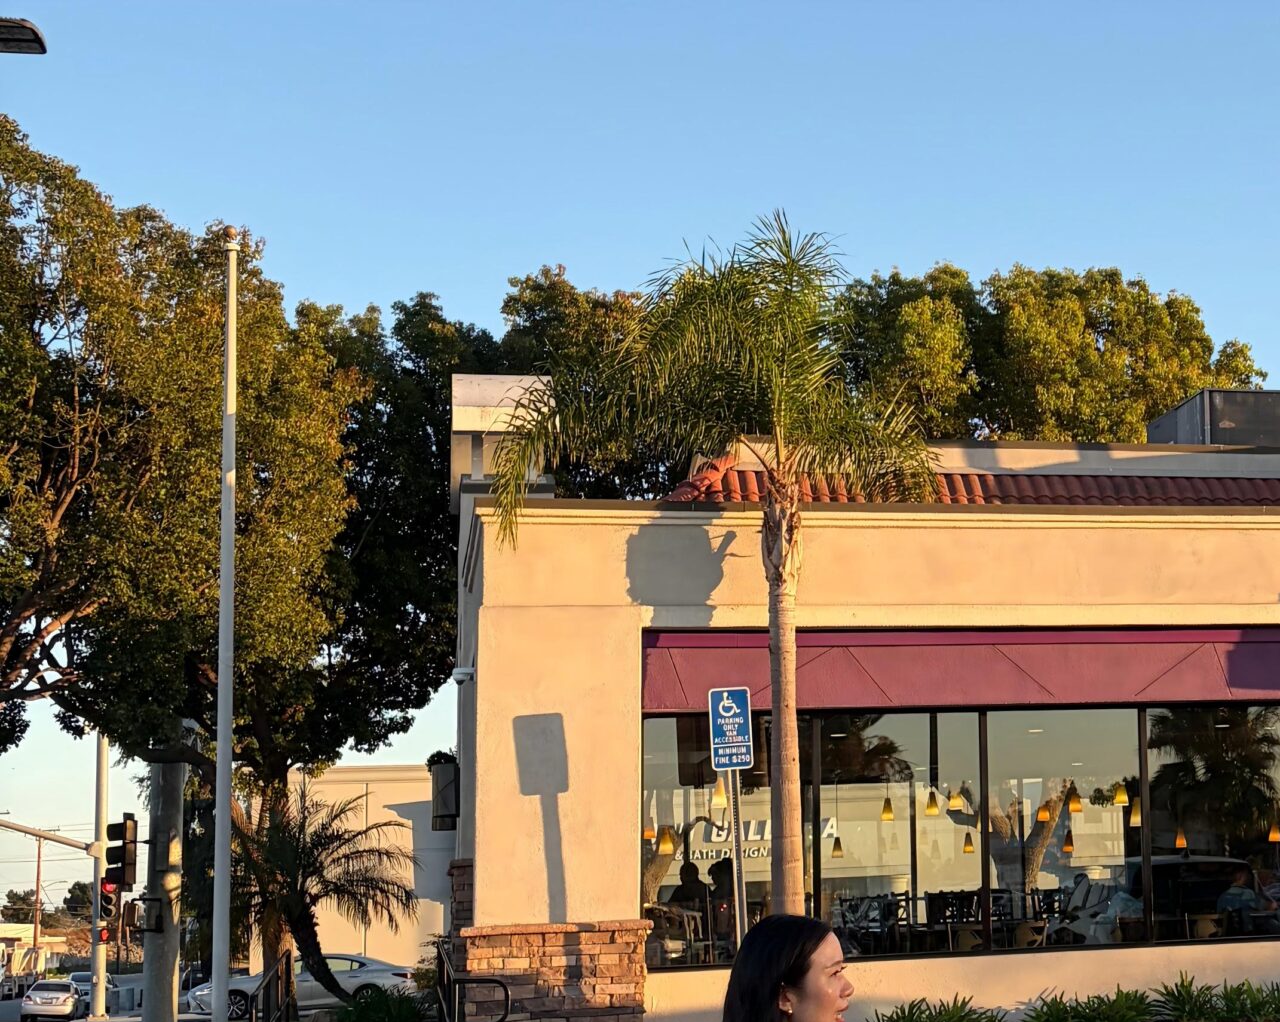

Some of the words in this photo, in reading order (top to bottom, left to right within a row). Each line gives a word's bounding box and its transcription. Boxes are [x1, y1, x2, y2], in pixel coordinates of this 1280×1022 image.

[717, 717, 744, 725] PARKING
[714, 735, 749, 743] ACCESSIBLE
[718, 746, 746, 755] MINIMUM
[715, 756, 730, 765] FINE
[732, 755, 750, 763] $250
[688, 849, 716, 859] ATH
[720, 846, 768, 859] DIGN
